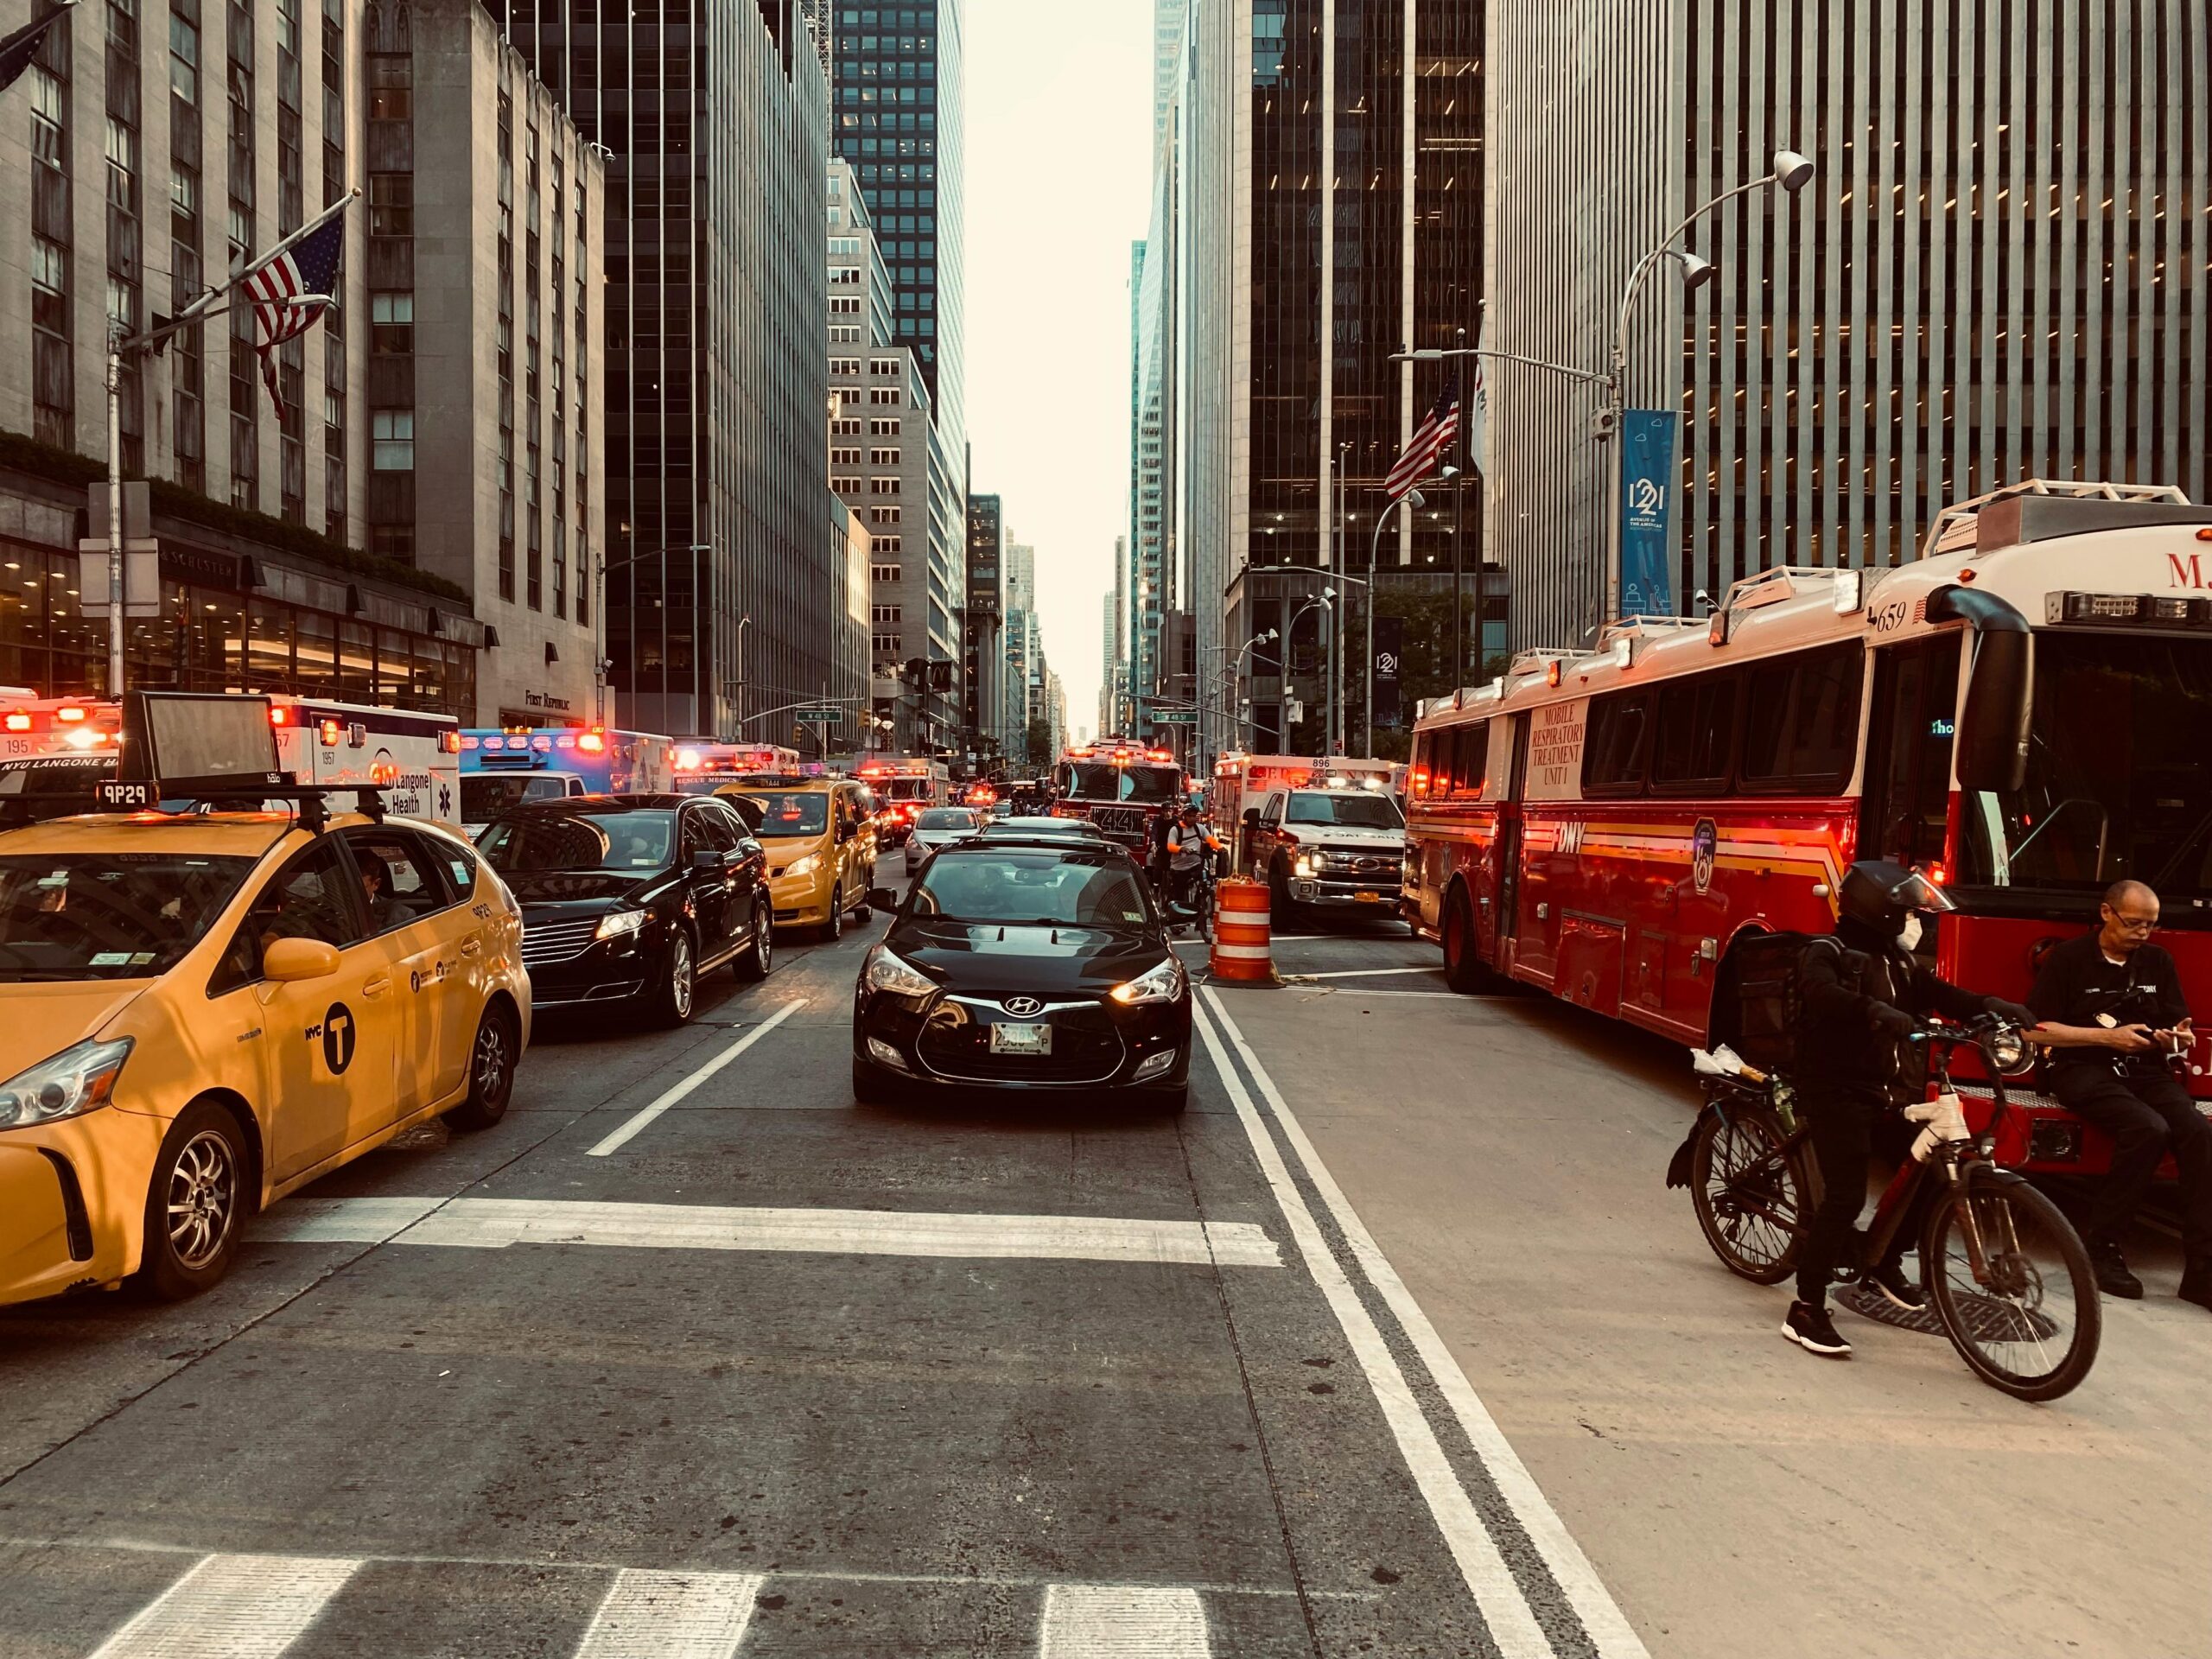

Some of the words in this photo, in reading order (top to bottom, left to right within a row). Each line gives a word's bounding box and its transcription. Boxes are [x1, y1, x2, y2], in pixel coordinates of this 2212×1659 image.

[1877, 601, 1906, 632] 659
[1544, 704, 1575, 726] MOBILE
[1532, 723, 1585, 747] RESPIRATORY
[2, 761, 30, 771] NYU
[32, 758, 102, 768] LANGONE
[1534, 744, 1580, 766] TREATMENT
[396, 774, 429, 791] Langone
[1545, 766, 1562, 785] UNIT
[105, 785, 145, 804] 9P29
[392, 794, 420, 814] Health
[1102, 808, 1134, 833] 44
[1552, 821, 1587, 854] FDNY
[305, 1024, 321, 1040] NYC
